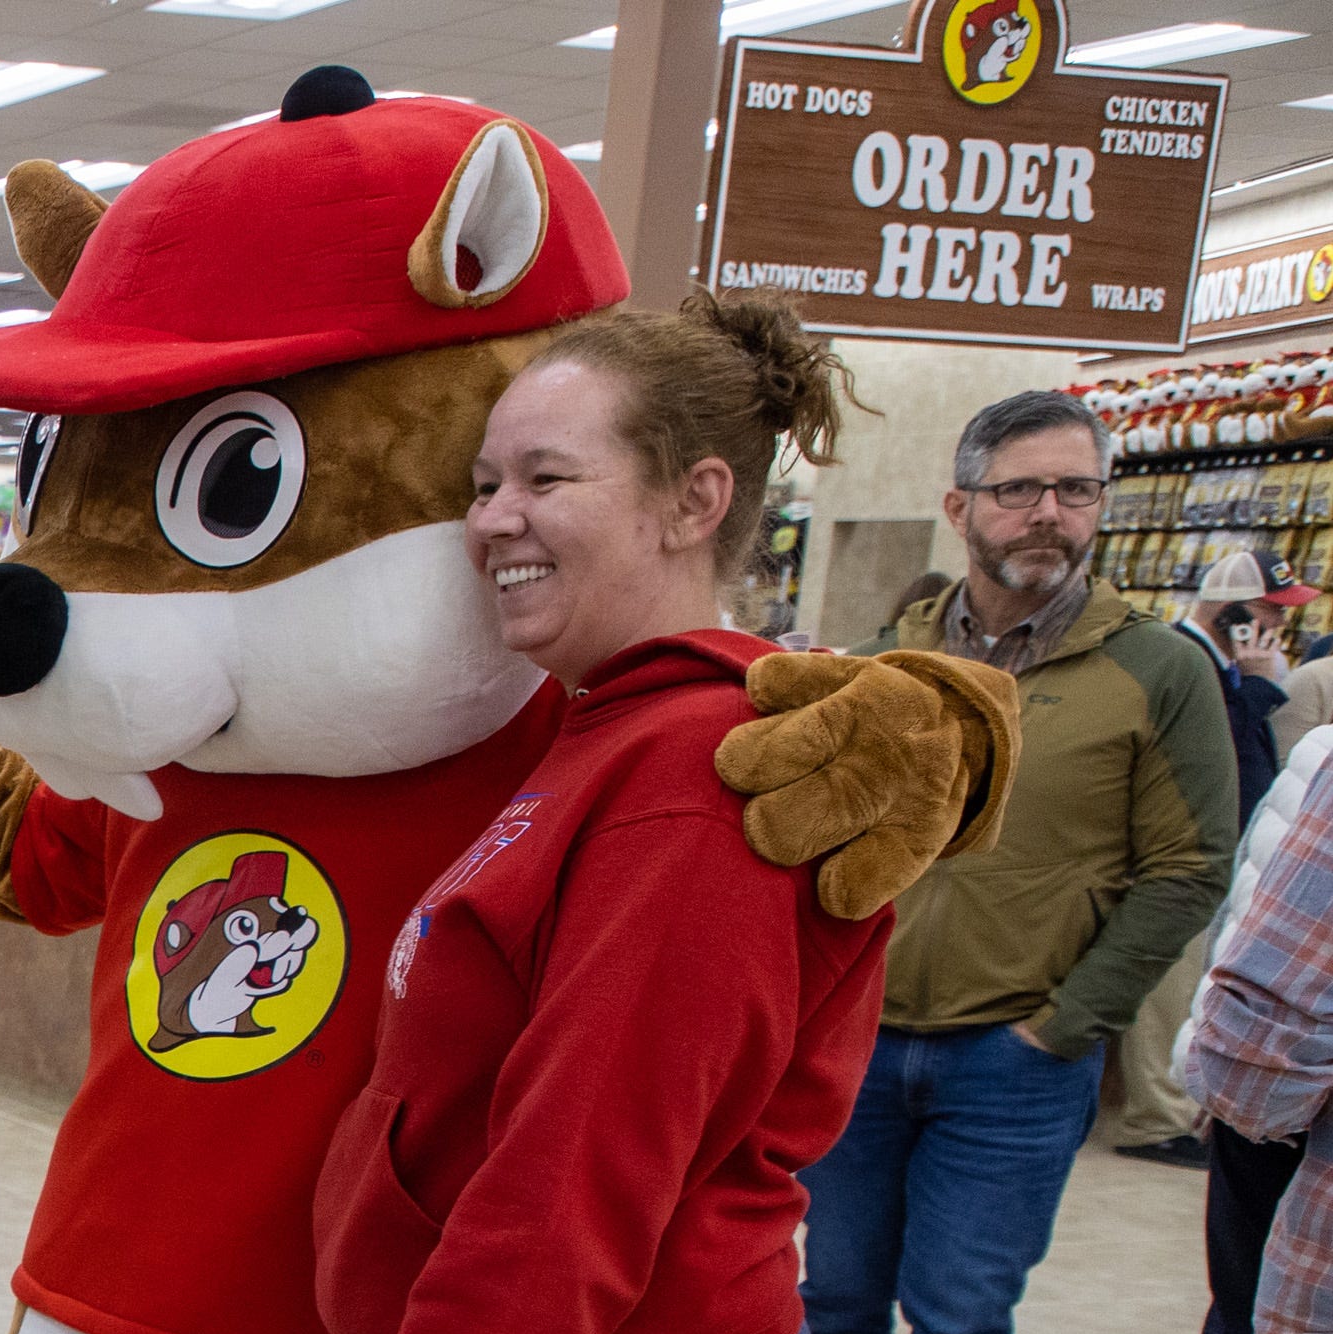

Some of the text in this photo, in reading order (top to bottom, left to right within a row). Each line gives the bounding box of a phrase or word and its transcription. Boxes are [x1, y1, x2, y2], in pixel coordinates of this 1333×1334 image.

[745, 81, 873, 116] HOT DOGS
[1104, 95, 1209, 127] CHICKEN
[1100, 128, 1205, 159] TENDERS
[852, 131, 1095, 222] ORDER
[720, 260, 868, 295] SANDWICHES
[873, 222, 1071, 308] HERE
[1091, 283, 1166, 312] WRAPS
[1237, 250, 1314, 316] JERKY
